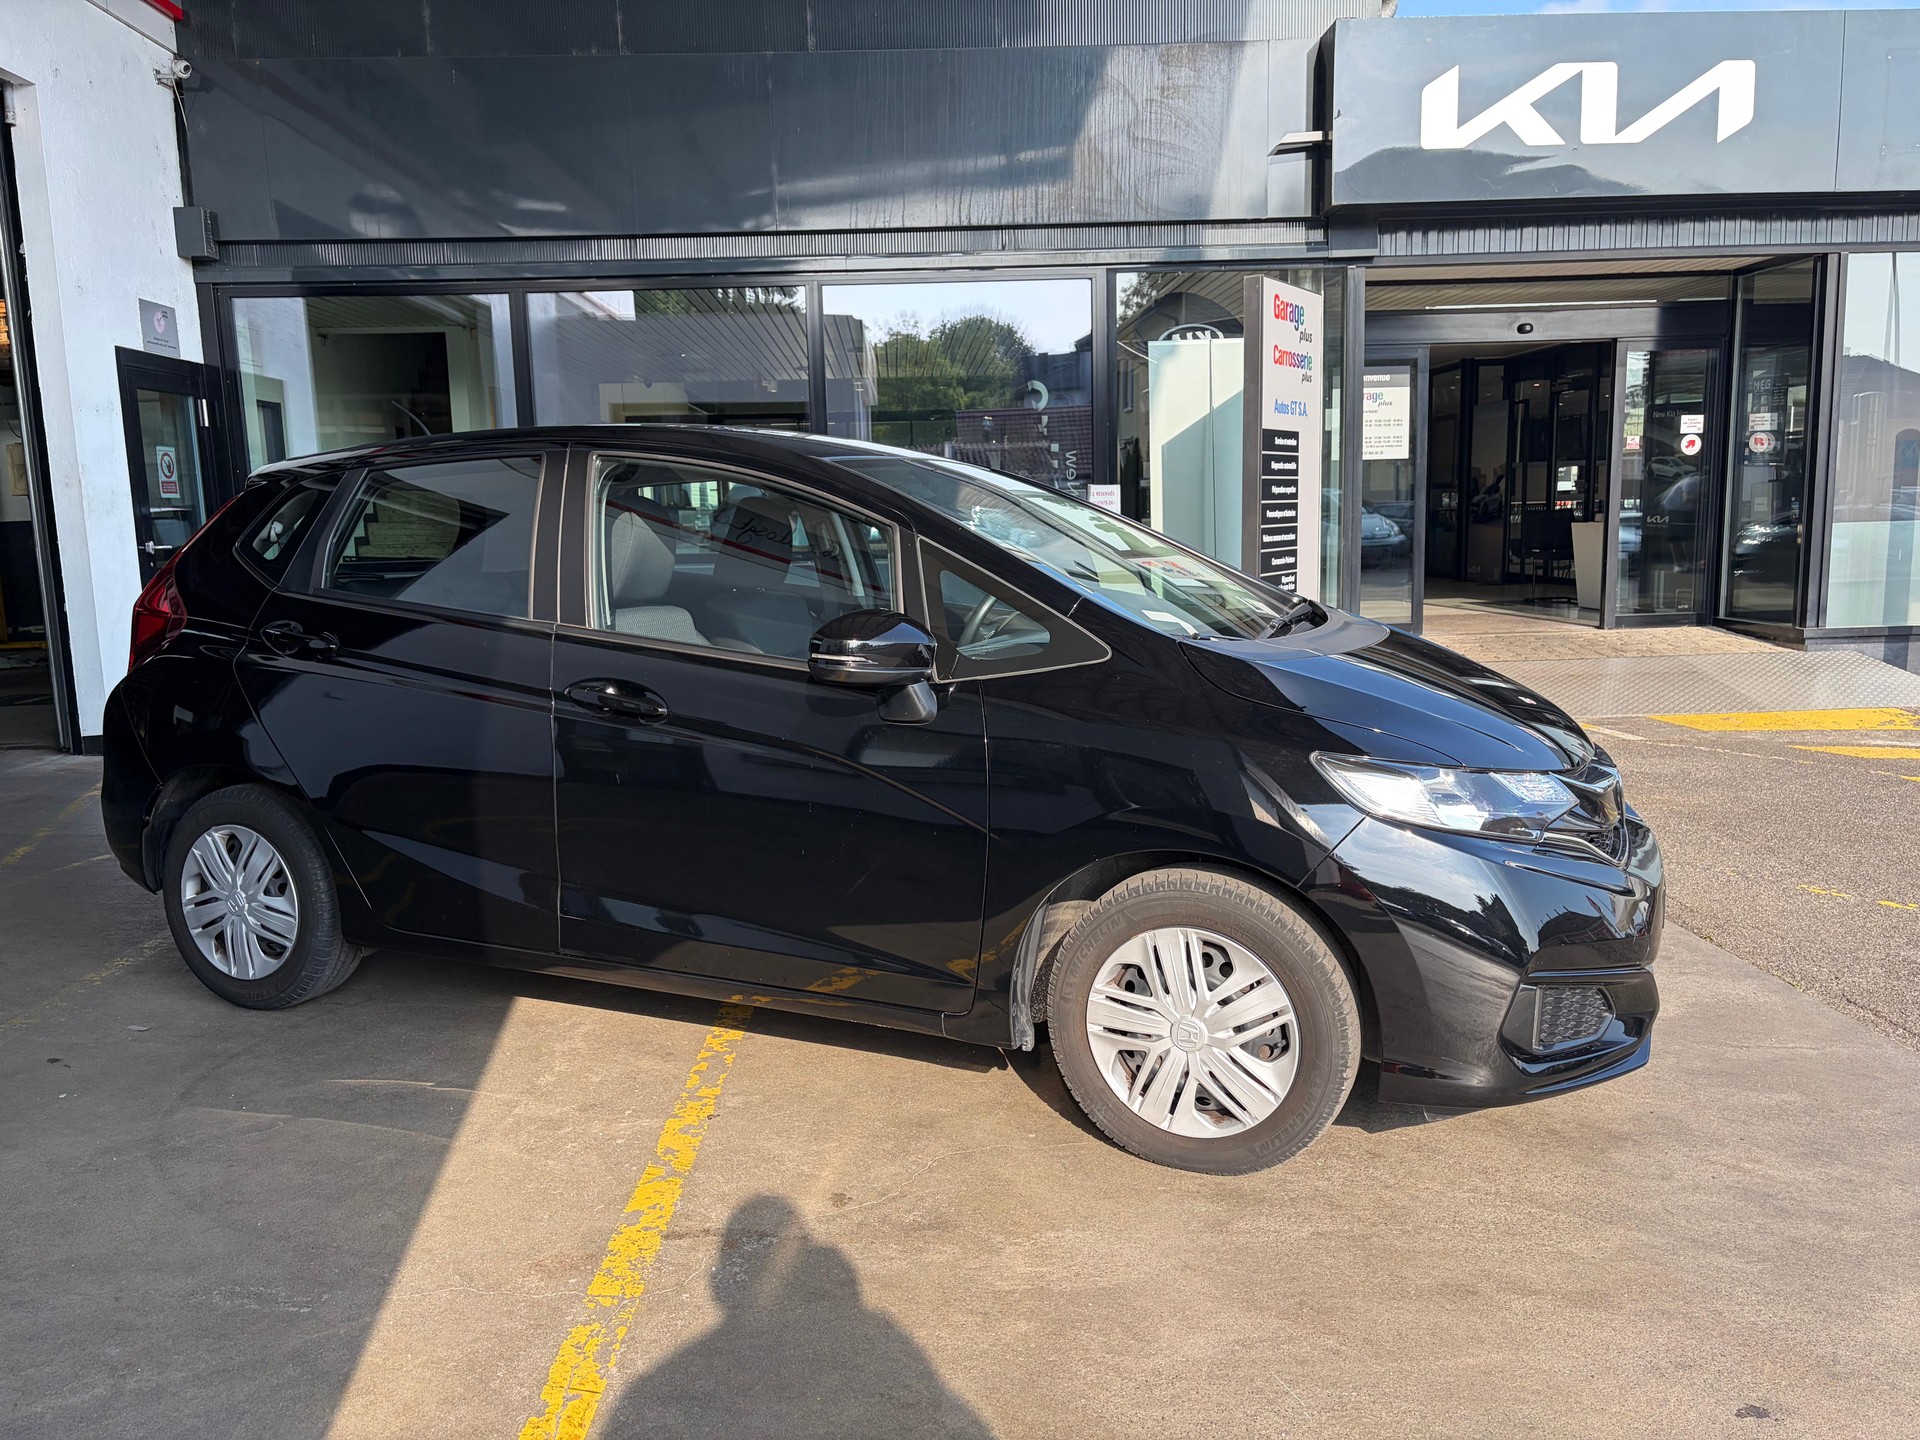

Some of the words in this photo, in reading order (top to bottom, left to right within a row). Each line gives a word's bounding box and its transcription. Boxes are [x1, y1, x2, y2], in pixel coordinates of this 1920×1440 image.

[1420, 59, 1756, 150] KIA
[1273, 293, 1305, 331] Garage
[1299, 329, 1313, 344] plus
[1273, 344, 1313, 371] Carrosserie
[1301, 372, 1313, 384] plus
[1274, 398, 1290, 415] Autos
[1291, 400, 1298, 416] GT
[1377, 399, 1393, 407] plus
